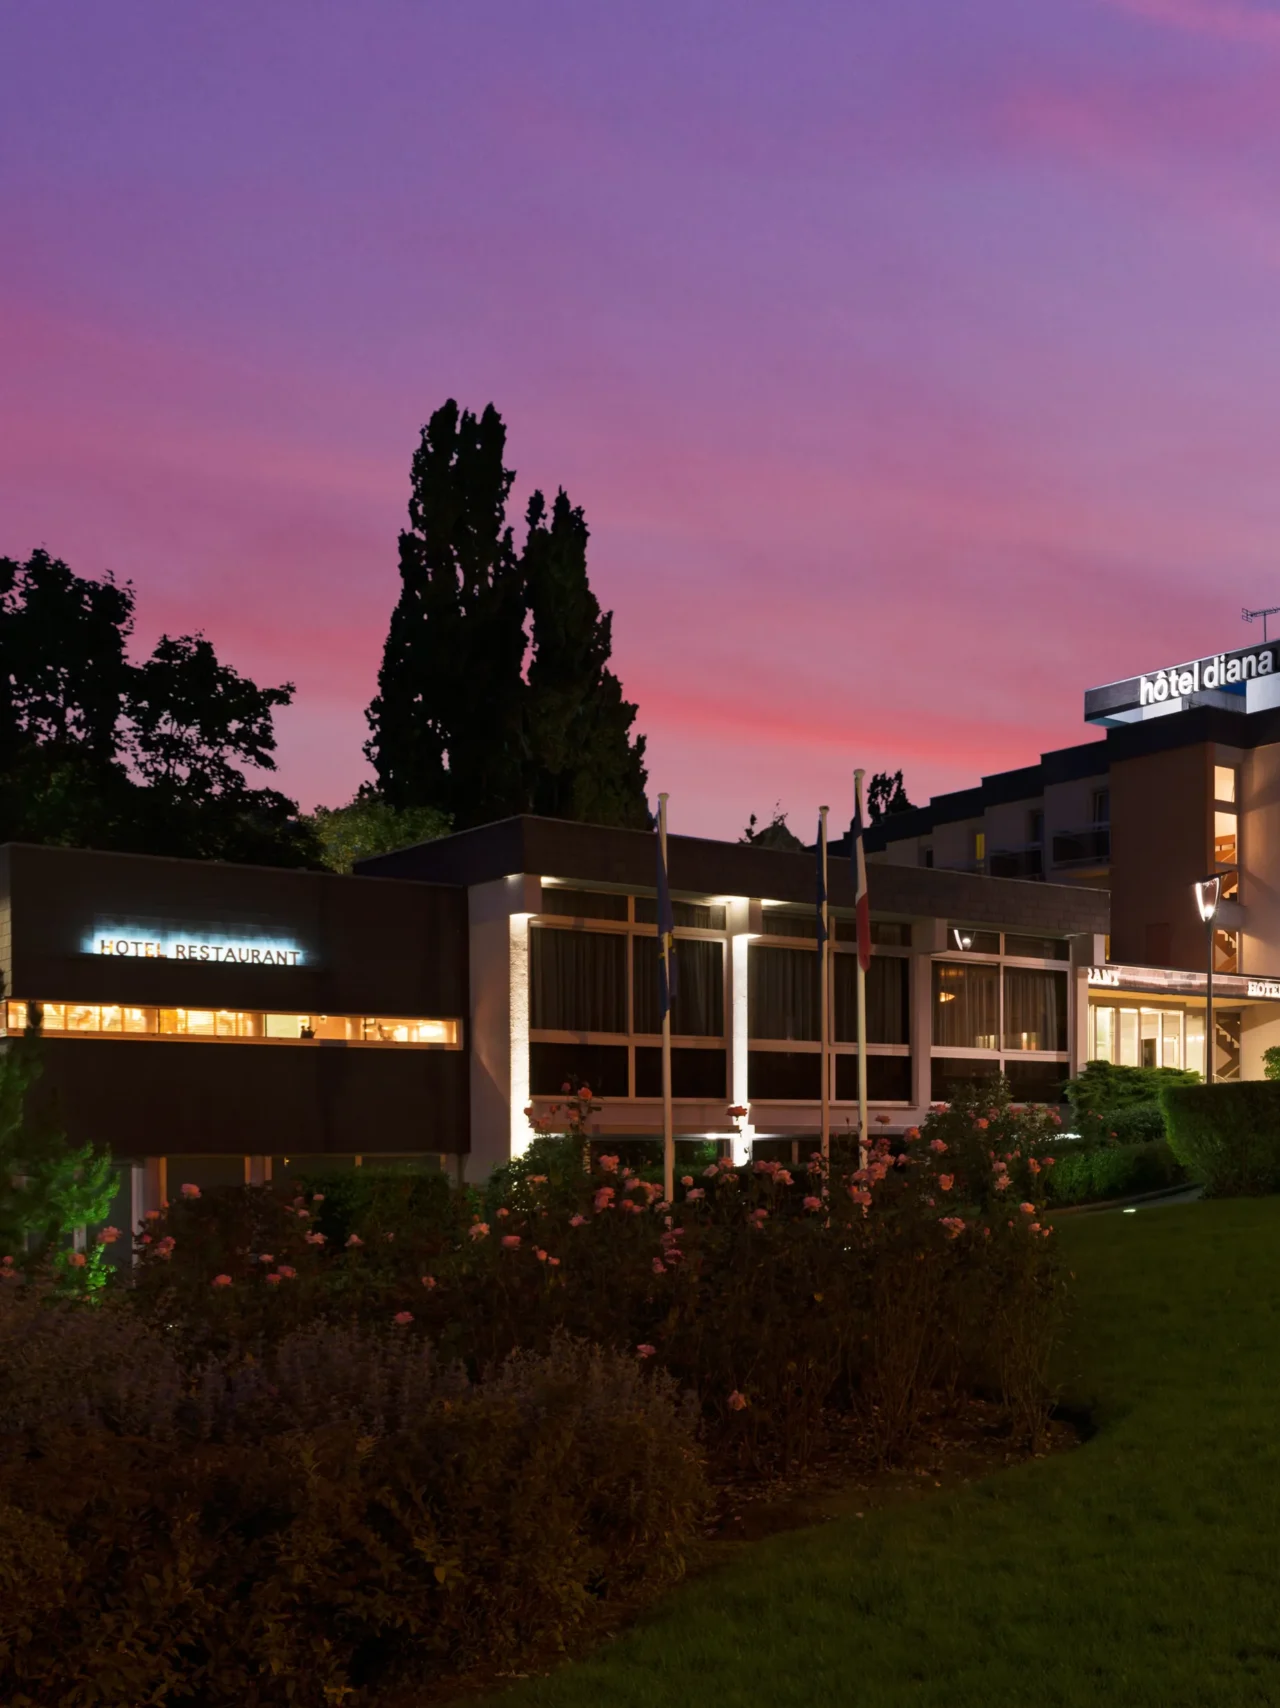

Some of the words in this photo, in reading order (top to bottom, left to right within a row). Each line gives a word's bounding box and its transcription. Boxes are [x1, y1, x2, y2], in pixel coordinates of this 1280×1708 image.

[1140, 660, 1200, 705] hôtel
[1203, 649, 1273, 690] diana
[101, 940, 167, 958] HOTEL
[176, 945, 300, 966] RESTAURANT
